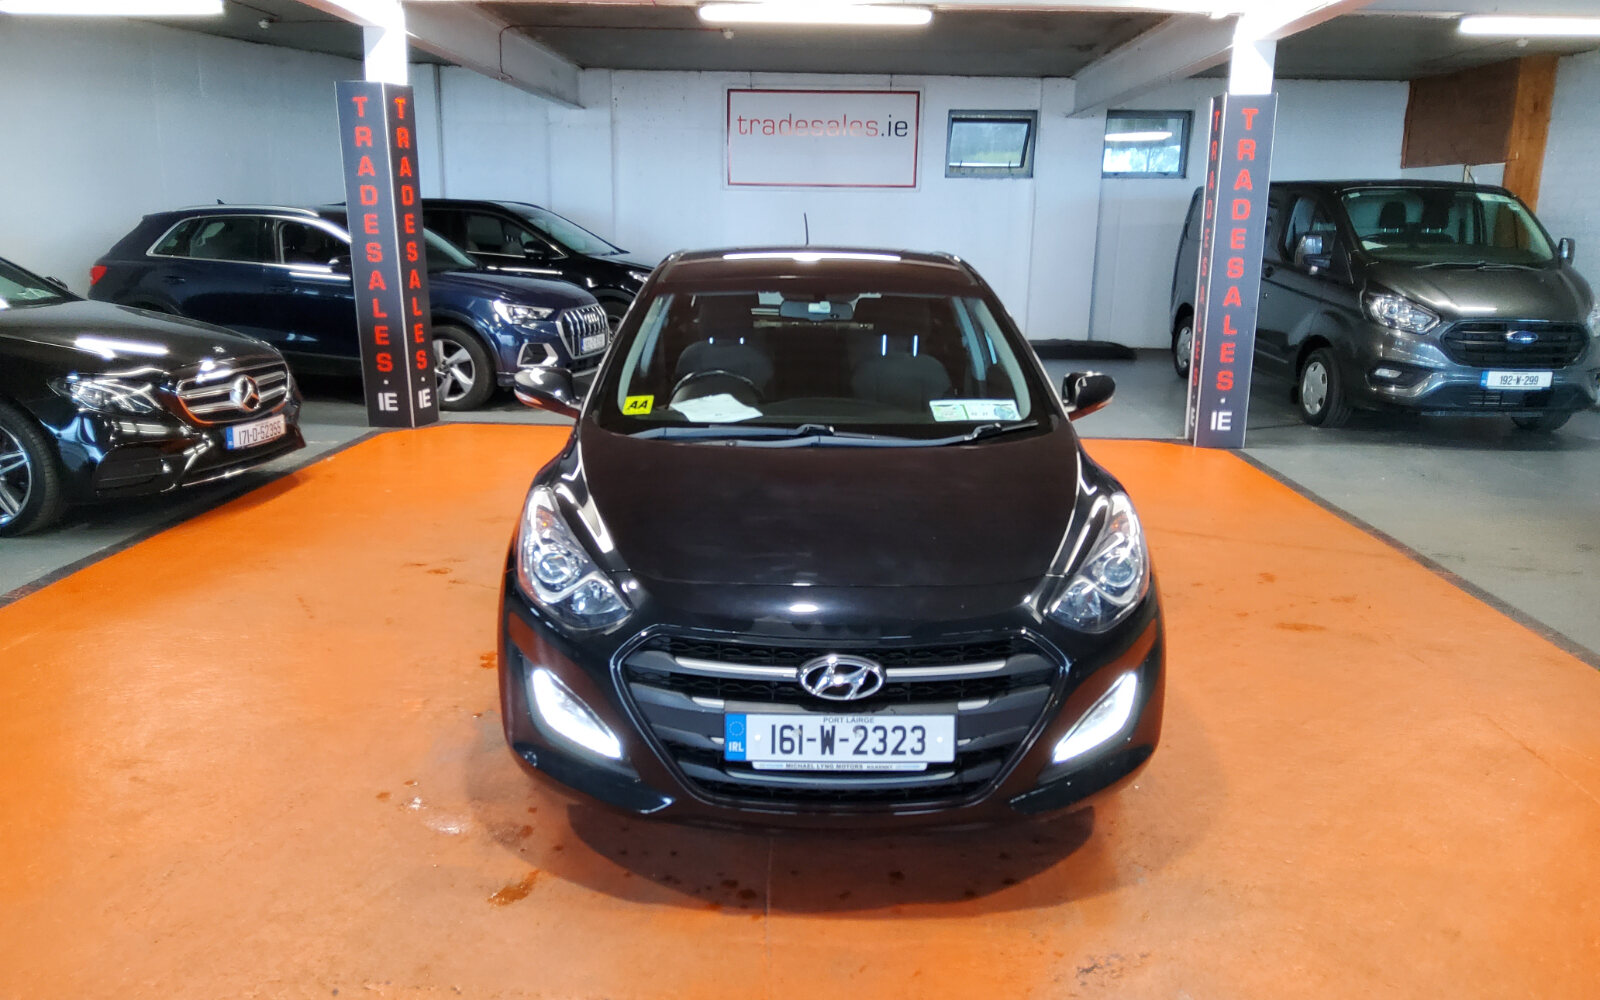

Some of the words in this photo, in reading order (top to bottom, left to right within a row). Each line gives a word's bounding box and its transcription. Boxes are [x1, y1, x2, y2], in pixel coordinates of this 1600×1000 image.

[737, 113, 908, 137] tradesales.ie
[628, 400, 649, 409] AA
[823, 716, 844, 724] PORT
[771, 724, 926, 756] 161-W-2323
[728, 741, 745, 753] IRL
